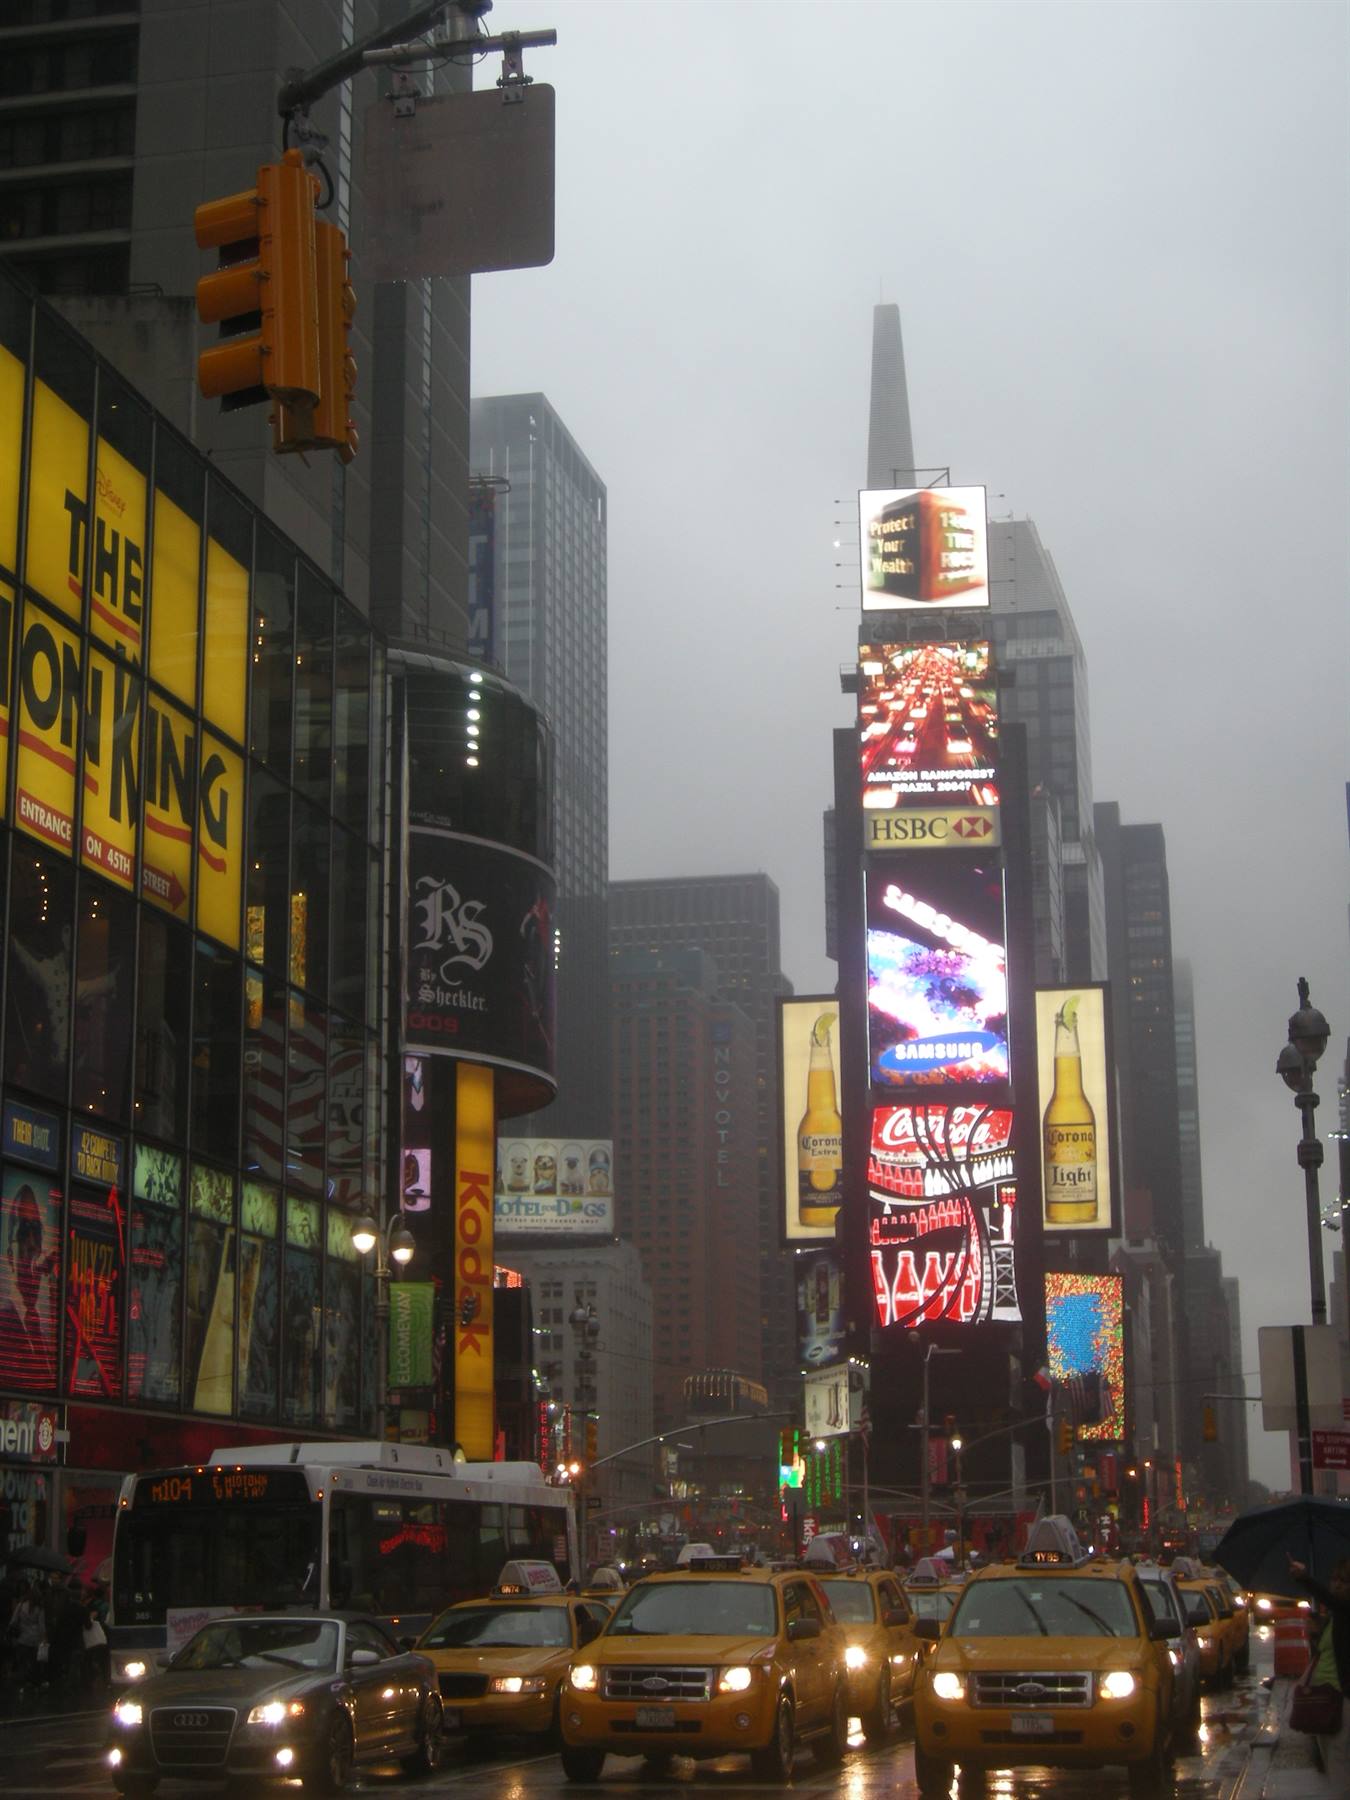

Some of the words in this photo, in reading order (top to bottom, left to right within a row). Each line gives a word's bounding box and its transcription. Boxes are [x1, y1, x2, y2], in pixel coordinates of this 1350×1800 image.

[65, 488, 143, 626] THE
[877, 538, 905, 554] Your
[872, 557, 915, 575] Wealth
[110, 638, 229, 850] KING
[867, 770, 918, 783] AMAZON
[921, 768, 995, 781] RAINFOREST
[871, 816, 949, 841] HSBC
[20, 796, 72, 842] ENTRANCE
[86, 835, 102, 859] ON
[107, 848, 131, 876] 45TH
[143, 868, 170, 898] STREET
[895, 1041, 983, 1061] SAMSUNG
[713, 1047, 731, 1187] NOVOTEL
[1052, 1166, 1092, 1187] Light
[457, 1170, 490, 1357] Kodak
[151, 1475, 193, 1503] M104
